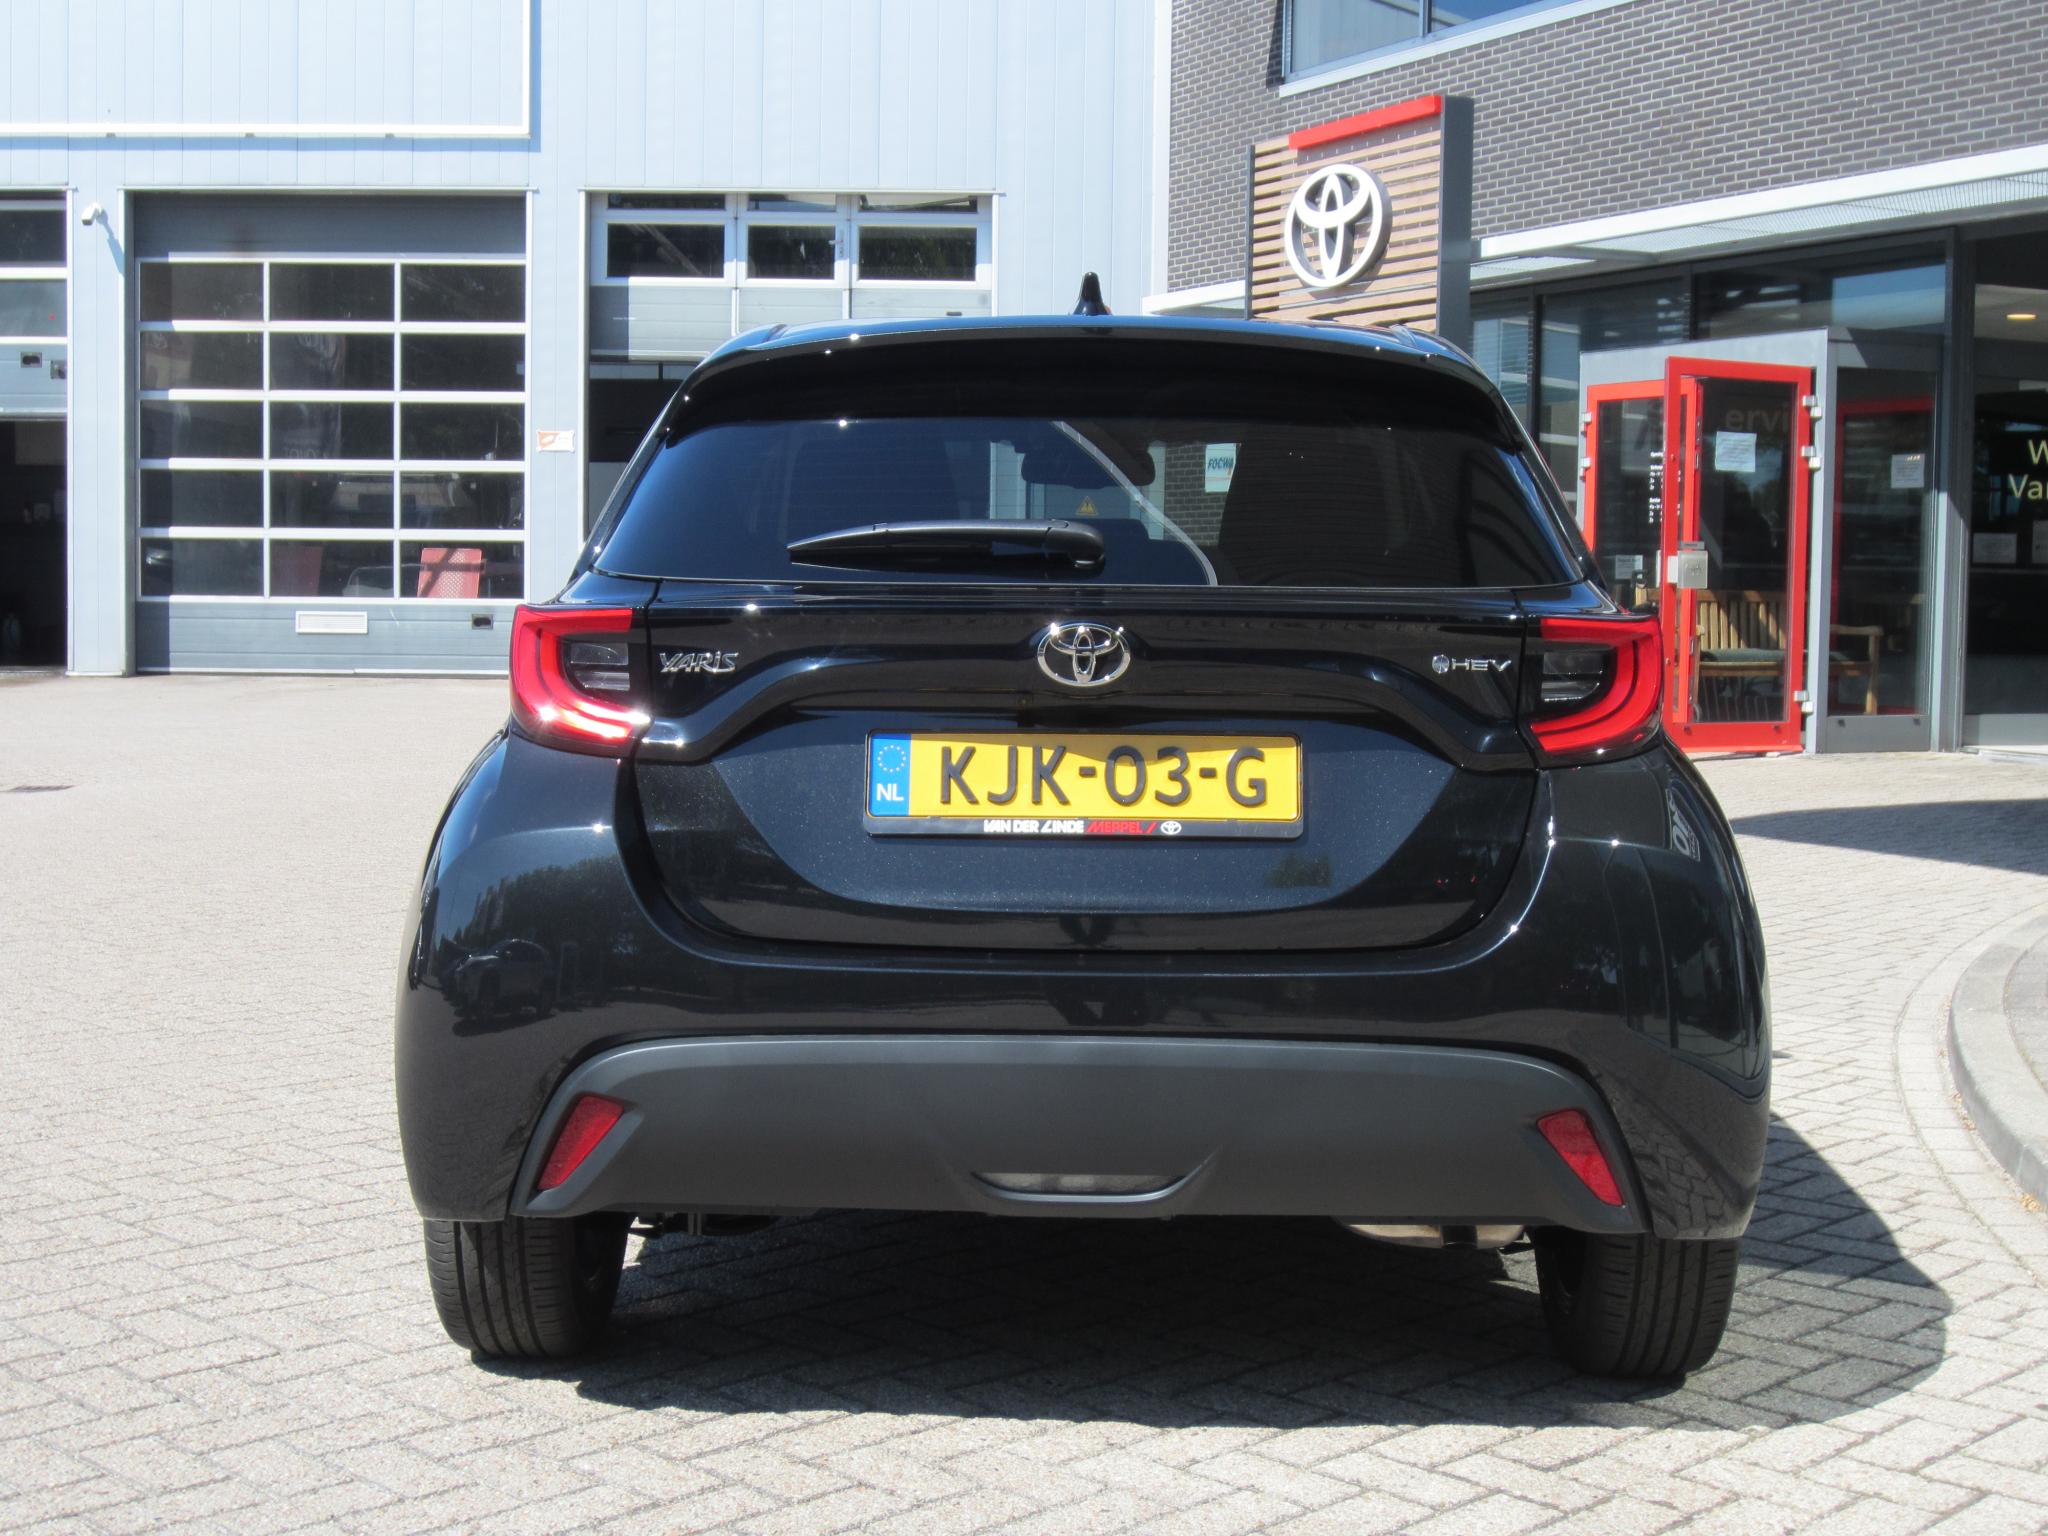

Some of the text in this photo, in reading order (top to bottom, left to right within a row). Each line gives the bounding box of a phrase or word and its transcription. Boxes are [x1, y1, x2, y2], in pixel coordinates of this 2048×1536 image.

[2008, 473, 2048, 500] Va
[1451, 657, 1512, 671] HEV
[940, 746, 1267, 806] KJK-03-G
[876, 783, 905, 801] NL
[983, 819, 1143, 835] VAN DER LINDE MEPPEL
